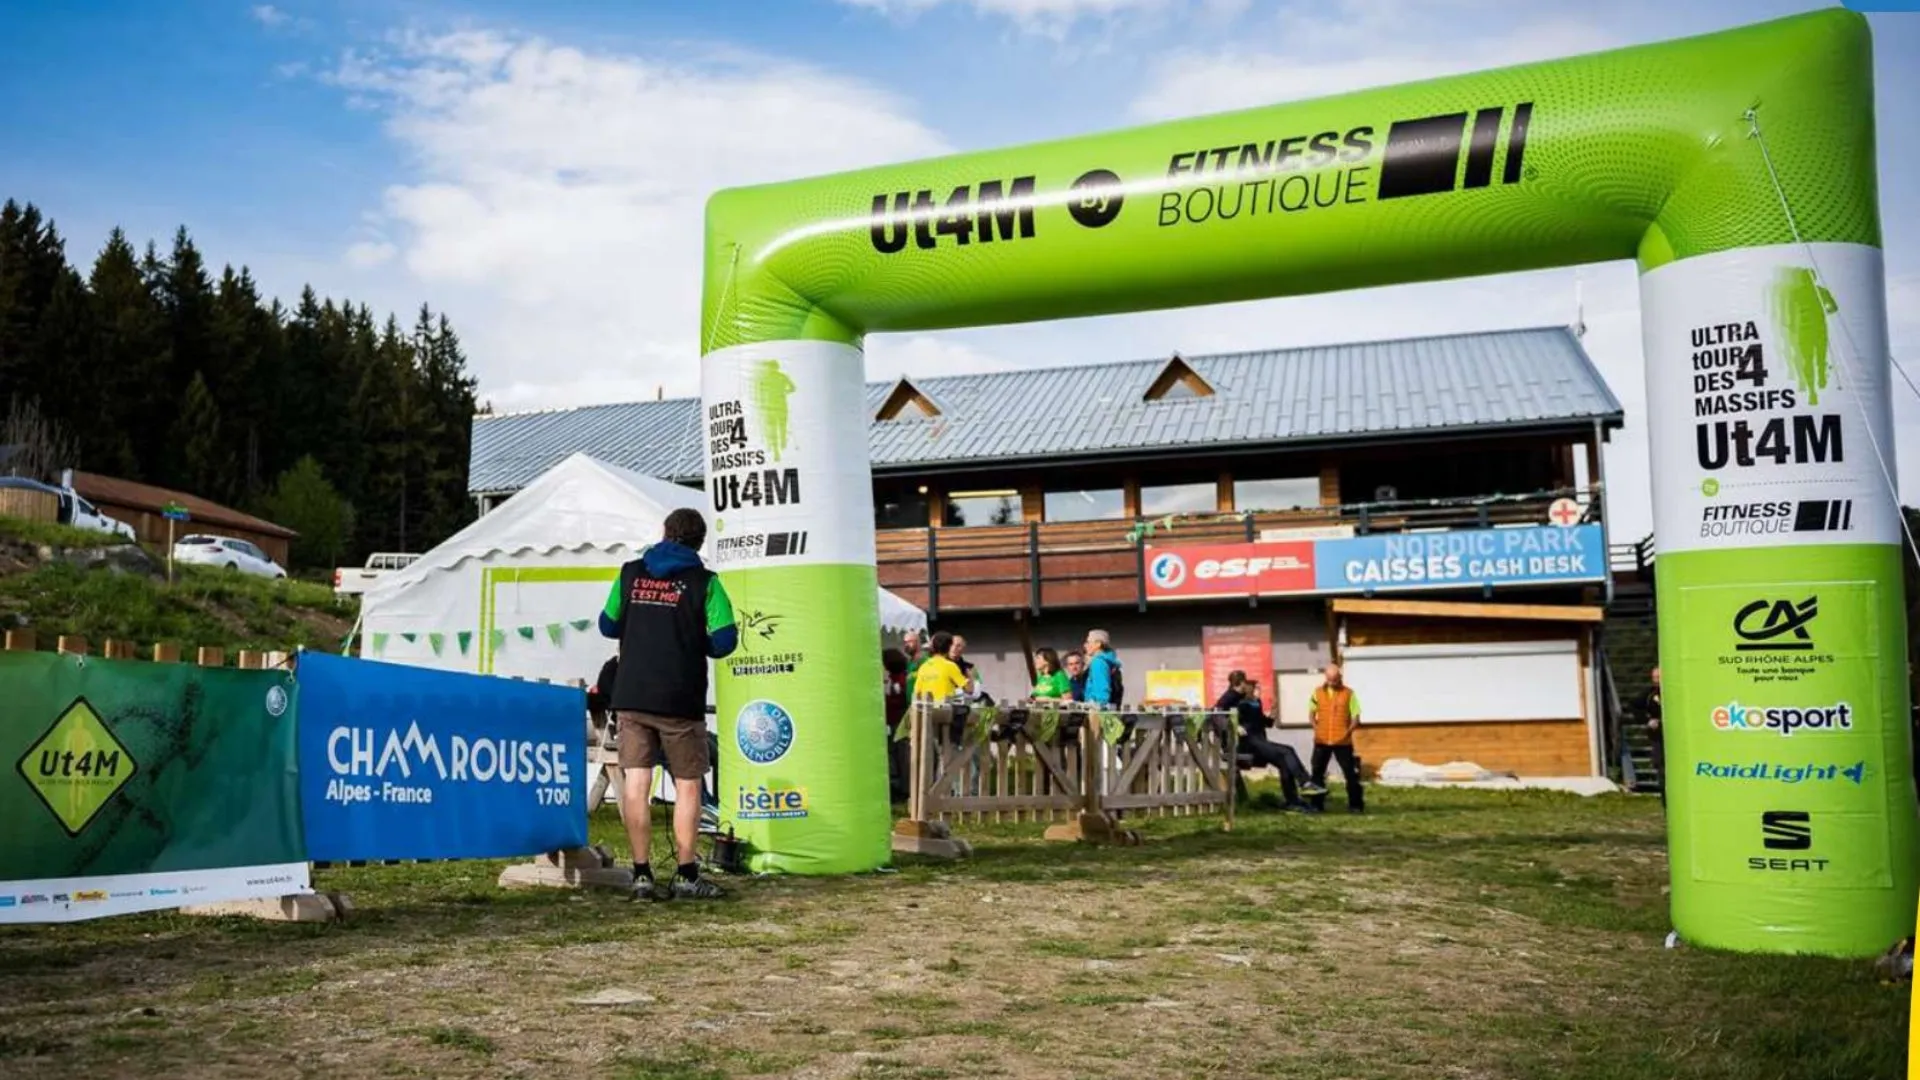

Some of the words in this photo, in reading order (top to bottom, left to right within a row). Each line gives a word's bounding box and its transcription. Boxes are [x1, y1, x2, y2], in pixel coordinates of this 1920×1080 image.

[1166, 125, 1374, 177] FITNESS
[1157, 166, 1371, 226] BOUTIQUE
[871, 175, 1036, 254] Ut4M
[1080, 182, 1111, 213] by
[1691, 321, 1760, 347] ULTRA
[1693, 371, 1735, 394] DES
[1735, 343, 1769, 387] 4
[709, 400, 742, 420] ULTRA
[1695, 389, 1796, 417] MASSIFS
[711, 437, 730, 455] DES
[1697, 414, 1844, 471] Ut4M
[712, 450, 765, 472] MASSIFS
[712, 468, 801, 512] Ut4M
[1703, 501, 1792, 521] FITNESS
[1700, 517, 1791, 538] BOUTIQUE
[717, 533, 764, 551] FITNESS
[1385, 532, 1496, 559] NORDIC
[1503, 527, 1584, 552] PARK
[1346, 555, 1463, 583] CAISSES
[1469, 558, 1524, 578] CASH
[1529, 554, 1586, 574] DESK
[1718, 656, 1743, 665] SUD
[1745, 654, 1791, 664] RHÔNE
[1794, 655, 1834, 663] ALPES
[1736, 666, 1760, 674] Toute
[1781, 666, 1815, 675] banque
[1712, 703, 1851, 734] ekosport
[40, 750, 120, 777] Ut4M
[327, 719, 570, 784] CHAMROUSSE
[1695, 762, 1836, 784] RaidLight
[325, 779, 371, 806] Alpes
[382, 782, 432, 803] France
[536, 787, 570, 806] 1700
[739, 786, 803, 810] isère
[1748, 858, 1829, 872] SEAT
